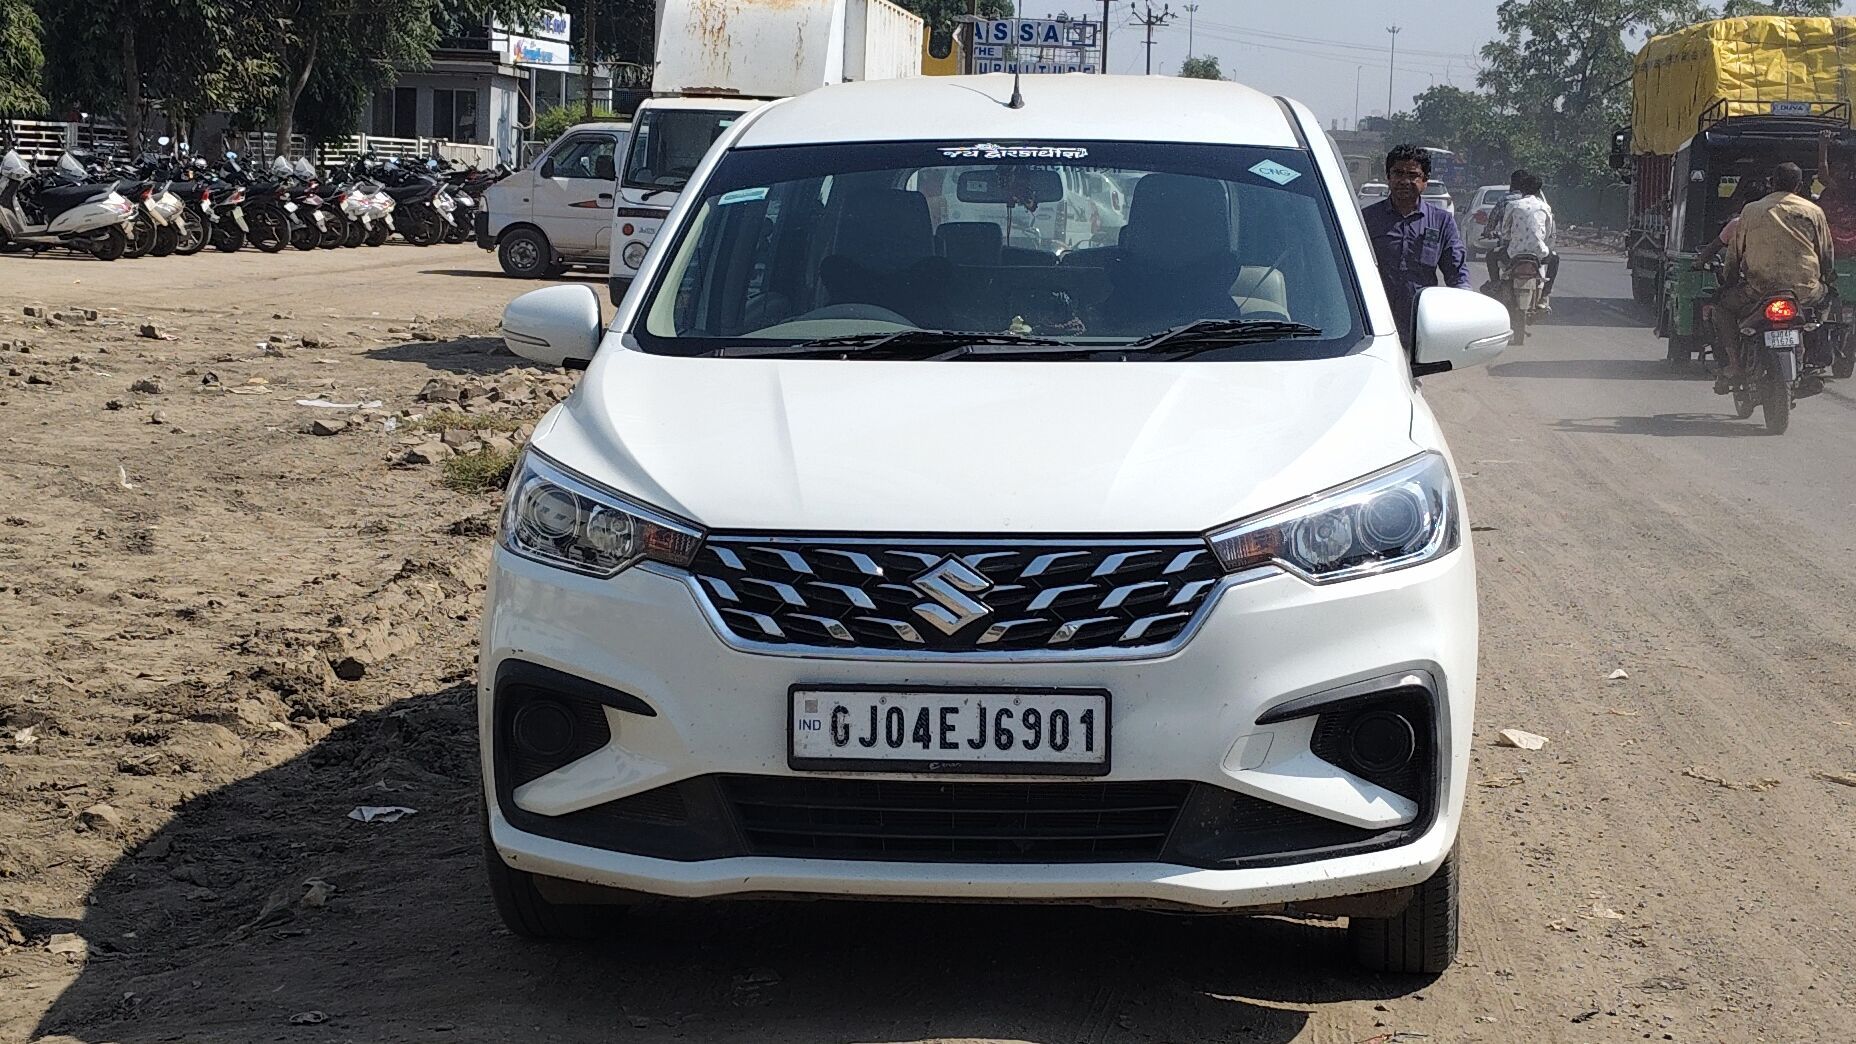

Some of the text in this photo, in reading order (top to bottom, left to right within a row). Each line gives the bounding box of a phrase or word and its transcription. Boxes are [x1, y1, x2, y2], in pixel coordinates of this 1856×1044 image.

[1259, 167, 1291, 177] CNG
[798, 704, 1095, 752] IND GJ04EJ6901
